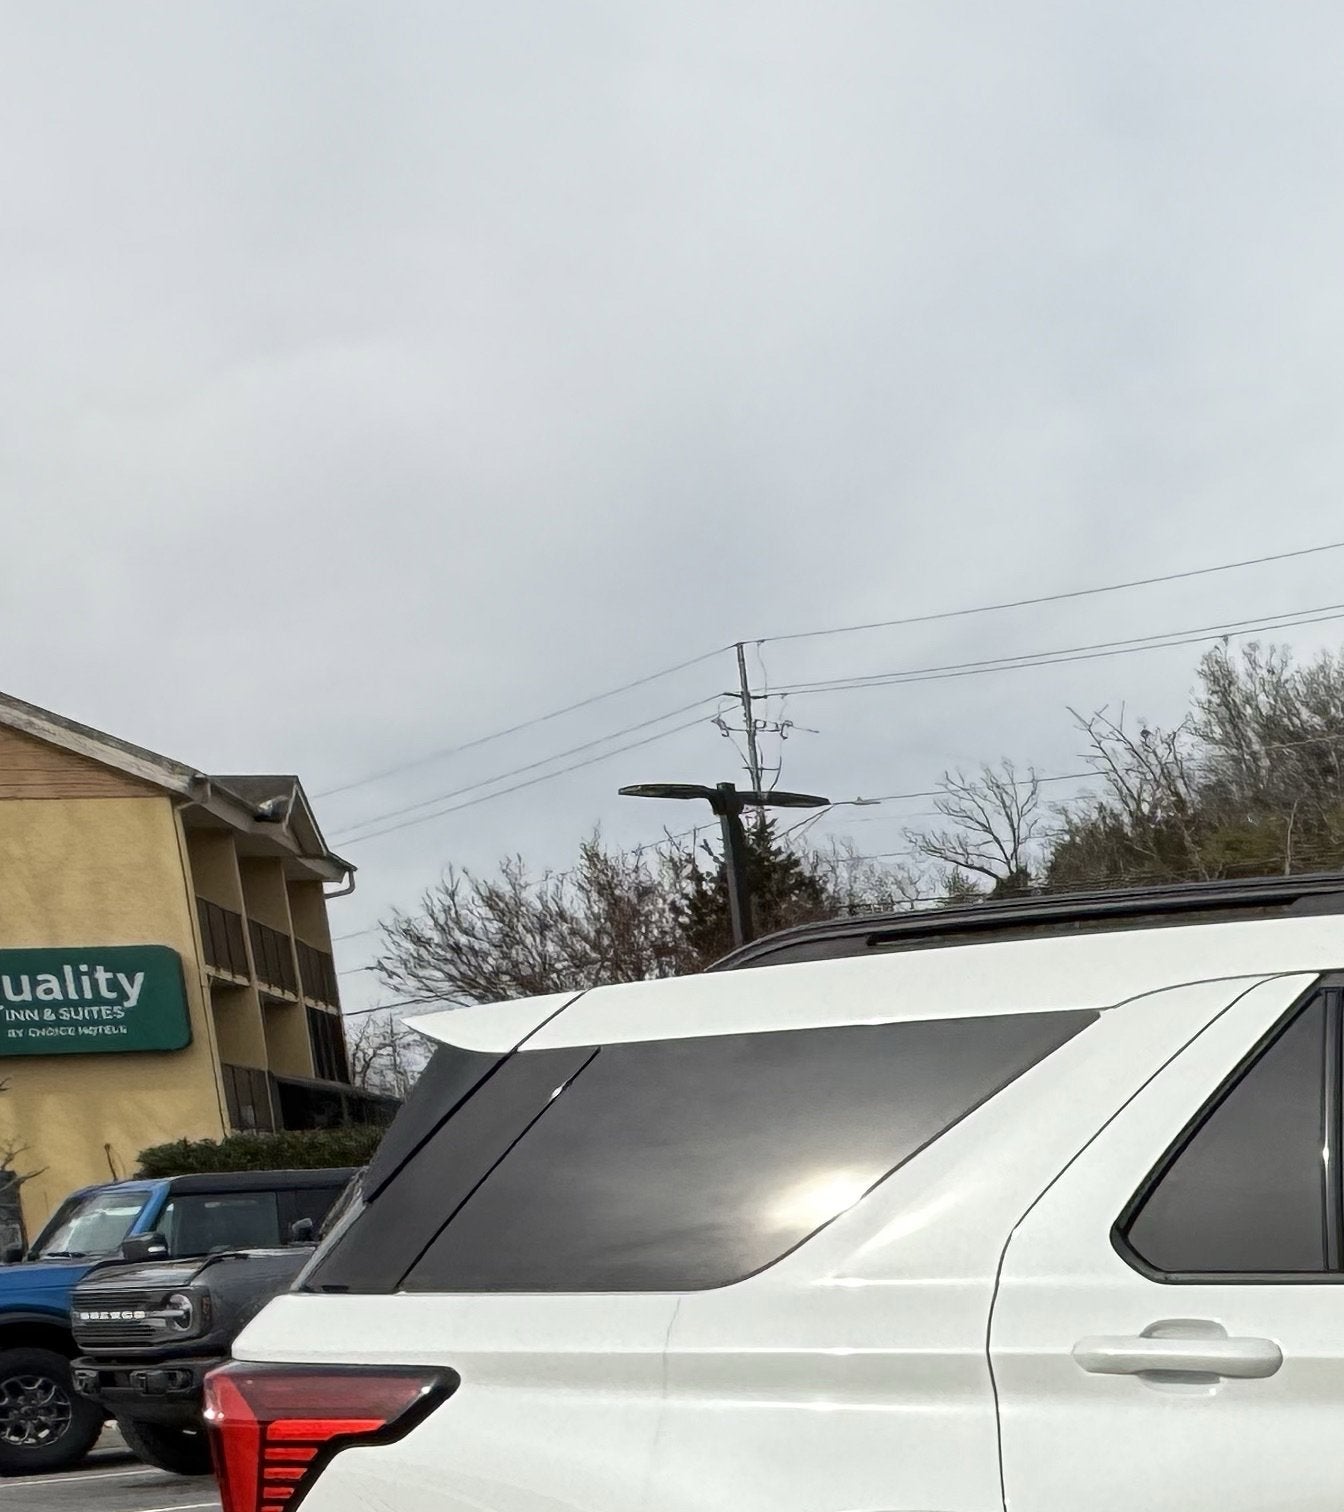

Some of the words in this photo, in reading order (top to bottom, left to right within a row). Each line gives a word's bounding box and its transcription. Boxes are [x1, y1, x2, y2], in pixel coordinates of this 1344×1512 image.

[0, 964, 145, 1010] uality
[5, 1008, 39, 1022] INN
[43, 1008, 56, 1021] &
[59, 1005, 126, 1021] SUITES
[7, 1028, 24, 1038] BY
